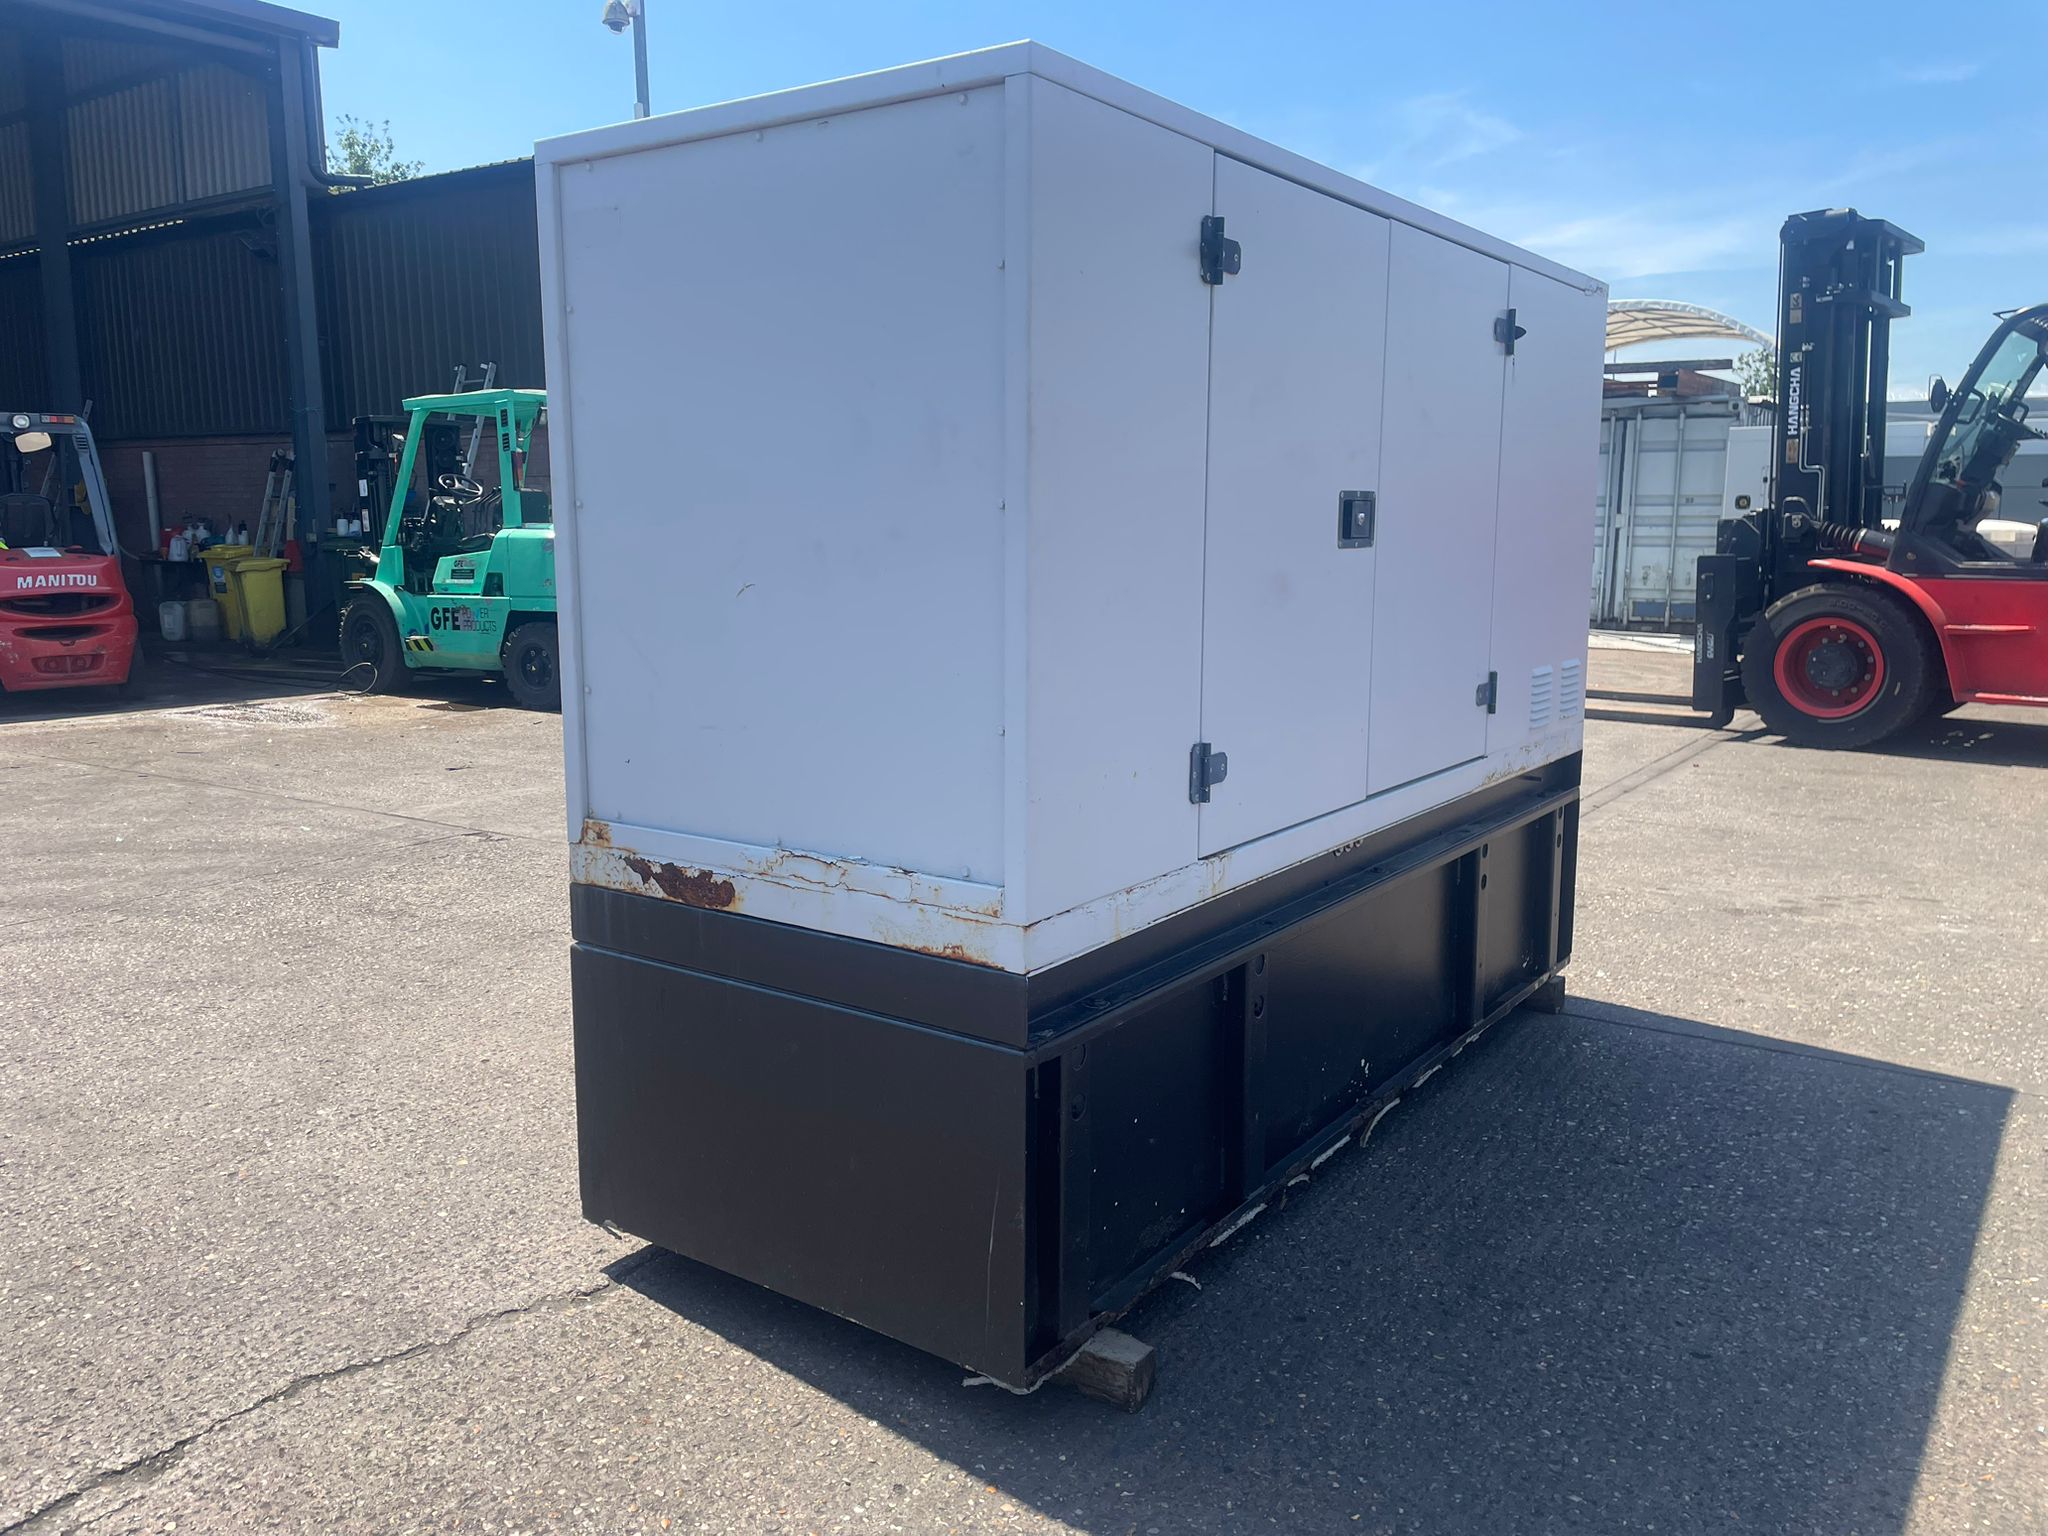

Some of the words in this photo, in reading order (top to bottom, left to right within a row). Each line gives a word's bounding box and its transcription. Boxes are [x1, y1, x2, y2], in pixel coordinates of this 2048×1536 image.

[1787, 366, 1801, 435] HANGCHA
[17, 574, 97, 589] MANITOU
[430, 607, 461, 631] GFE
